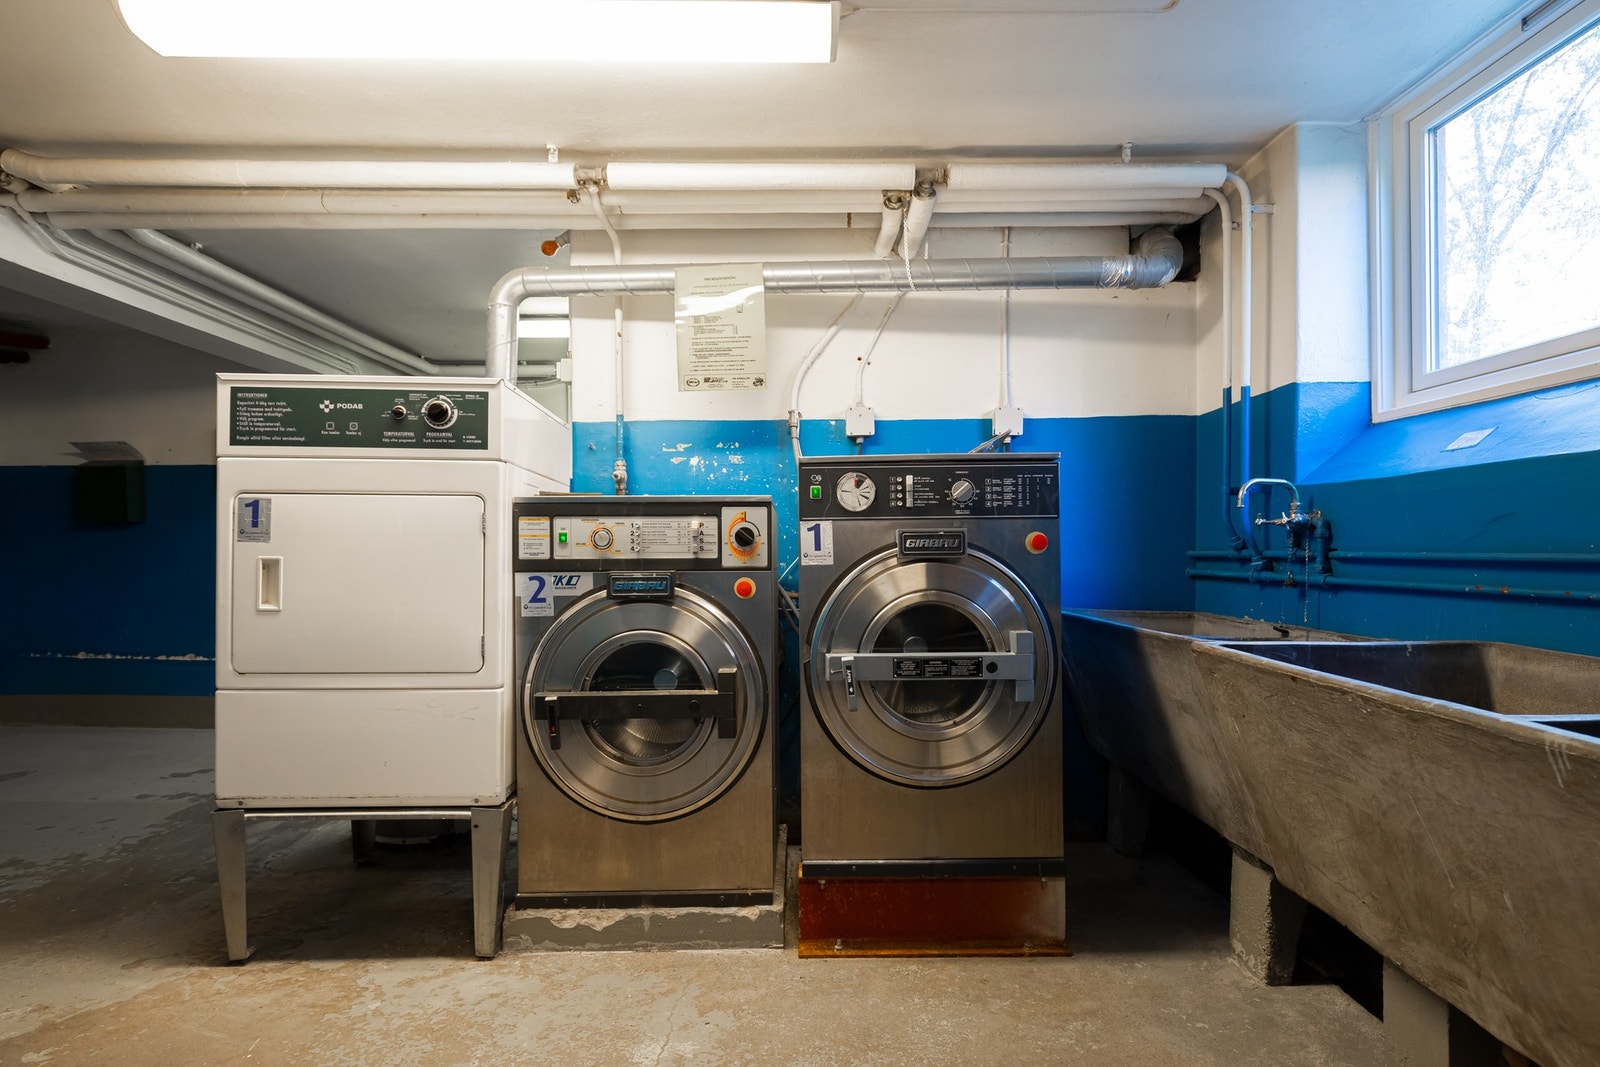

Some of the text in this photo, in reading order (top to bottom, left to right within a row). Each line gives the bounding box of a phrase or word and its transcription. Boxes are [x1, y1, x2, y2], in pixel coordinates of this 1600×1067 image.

[245, 500, 259, 528] 1
[807, 523, 821, 551] 1
[906, 539, 960, 547] GIRBAU
[528, 575, 546, 603] 2
[613, 581, 667, 590] GIRBAU
